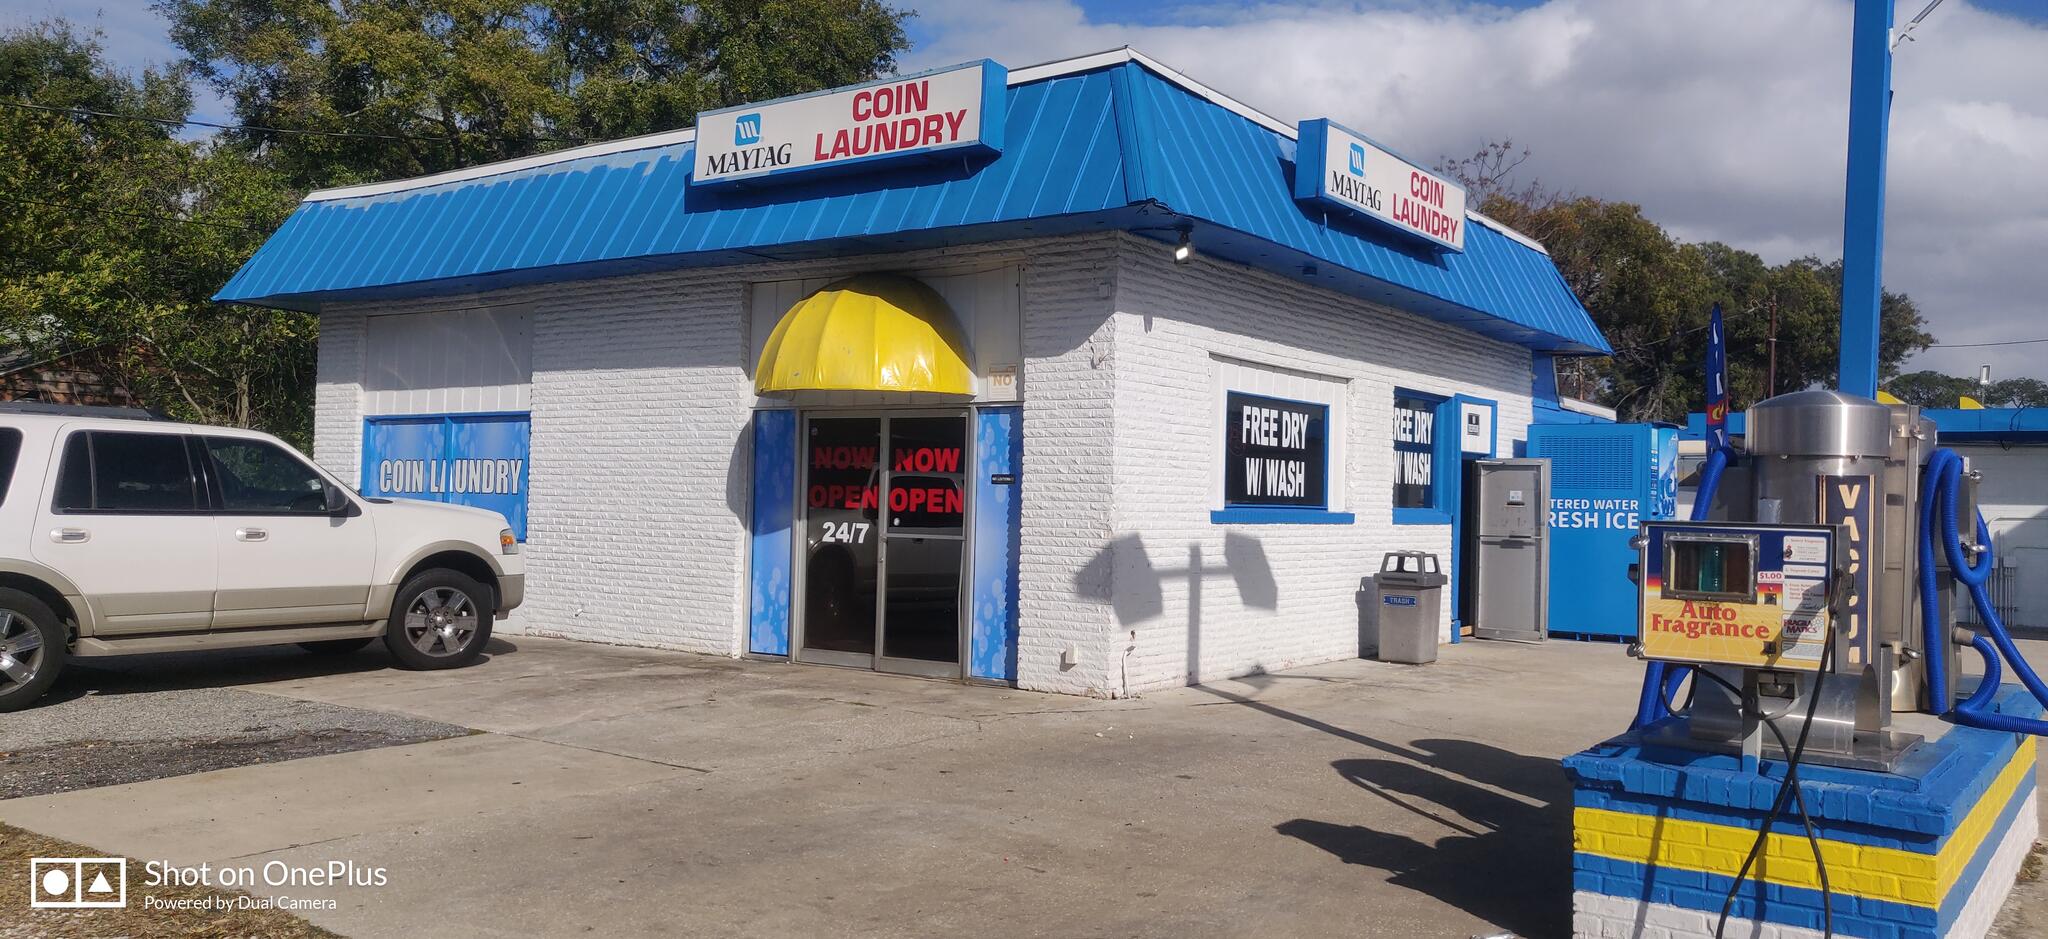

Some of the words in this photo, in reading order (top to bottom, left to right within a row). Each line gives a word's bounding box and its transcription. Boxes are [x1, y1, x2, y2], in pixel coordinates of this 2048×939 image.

[852, 81, 928, 122] COIN
[814, 109, 968, 161] LAUNDRY
[705, 143, 792, 176] MAYTAG
[1331, 170, 1381, 211] MAYTAG
[1410, 171, 1444, 209] COIN
[1392, 193, 1458, 243] LAUNDRY
[992, 375, 1012, 385] NO
[1242, 405, 1279, 447] FREE
[1282, 411, 1309, 449] DRY
[1393, 407, 1413, 442] REE
[1414, 411, 1433, 444] DRY
[815, 447, 876, 469] NOW
[895, 448, 960, 472] NOW
[1404, 452, 1431, 485] WASH
[379, 459, 424, 494] COIN
[430, 458, 524, 495] LAUNDRY
[1246, 457, 1263, 496] W/
[1266, 459, 1305, 497] WASH
[809, 485, 879, 509] OPEN
[889, 488, 963, 513] OPEN
[1550, 499, 1590, 510] TERED
[1593, 499, 1639, 510] WATER
[822, 521, 869, 544] 24/7
[1549, 511, 1598, 528] RESH
[1605, 512, 1640, 529] ICE
[1759, 572, 1782, 580] $1.00
[1679, 600, 1737, 621] Auto
[1652, 613, 1770, 639] Fragrance
